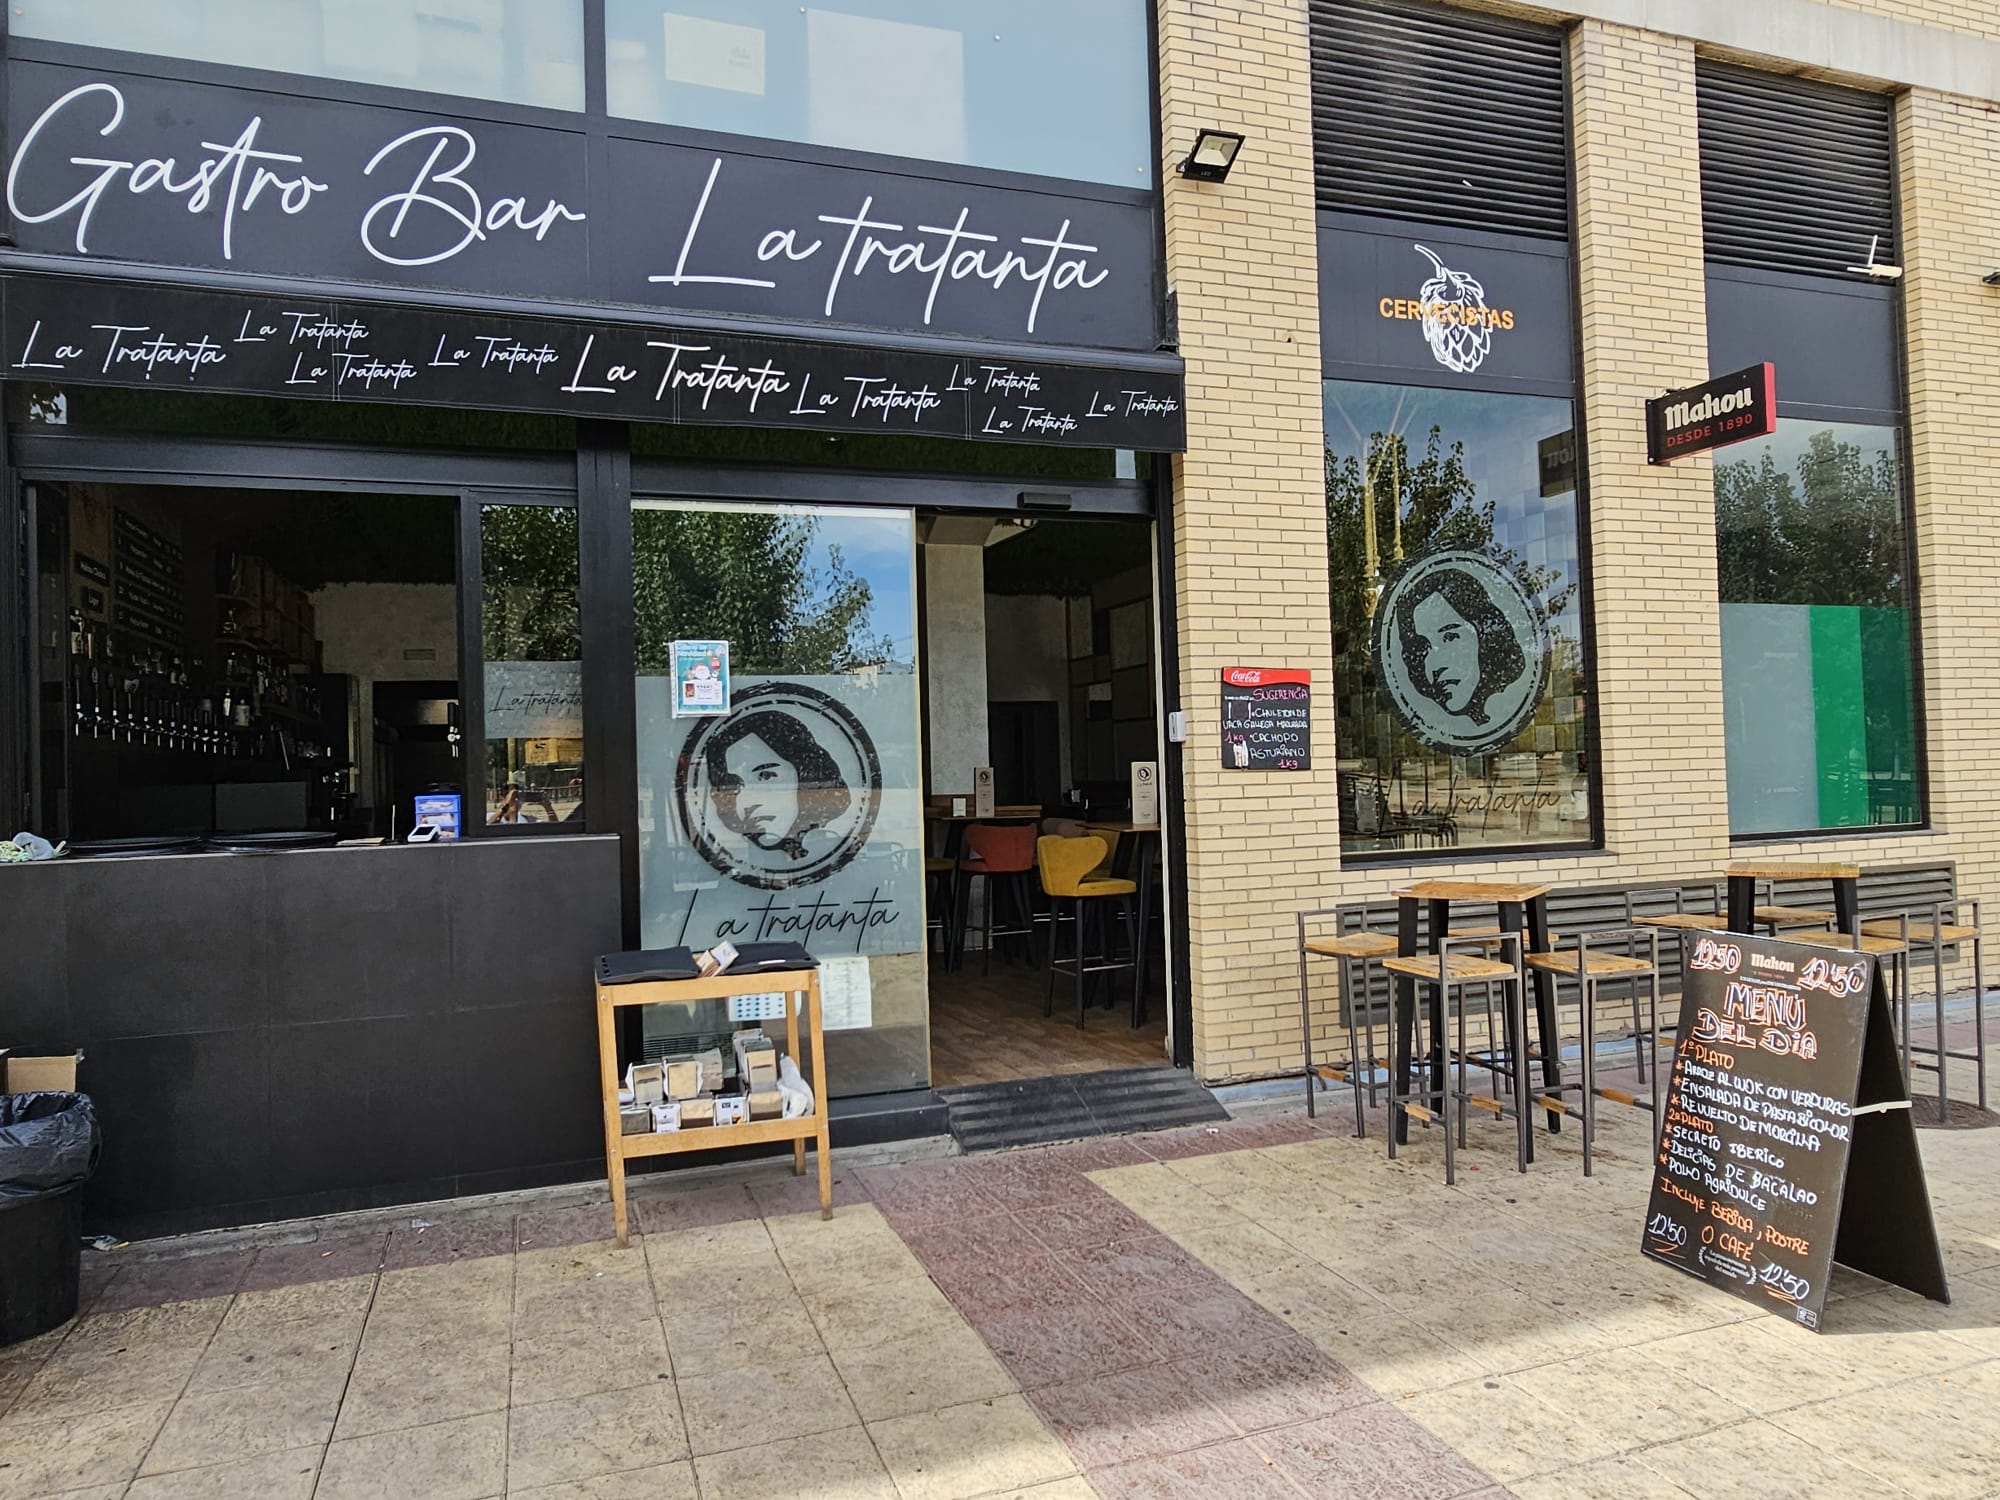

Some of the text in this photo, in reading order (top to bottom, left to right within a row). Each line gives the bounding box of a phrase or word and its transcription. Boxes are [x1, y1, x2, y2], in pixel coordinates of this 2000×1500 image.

[7, 83, 586, 266] Gastro Bar
[649, 158, 821, 288] La
[233, 310, 369, 349] La Tratanta
[1380, 298, 1514, 329] CERVECISTAS
[12, 321, 226, 380] La Tratanta
[428, 334, 559, 374] La Tratanta
[285, 352, 417, 390] La Tratanta
[561, 334, 791, 413] La Tratanta
[945, 364, 1041, 399] La Tratanta
[789, 372, 941, 423] La Tratanta
[1085, 390, 1179, 418] La Tratanta
[1664, 387, 1753, 431] Mahou
[982, 406, 1078, 437] La Tratanta
[1667, 413, 1752, 447] DESDE 1890
[488, 685, 525, 713] La
[1296, 709, 1307, 717] DE
[1222, 720, 1242, 730] VACA
[1251, 732, 1299, 743] CACHOPO
[1751, 953, 1795, 973] Mahou
[1692, 1008, 1756, 1049] DEL
[1694, 1045, 1735, 1070] PLATO
[1681, 1077, 1741, 1108] ENSALADA
[1743, 1096, 1760, 1112] DE
[1761, 1102, 1796, 1124] PASTA
[1718, 1072, 1733, 1087] AL
[1734, 1076, 1764, 1095] WOK
[1767, 1087, 1788, 1100] CON
[1792, 1090, 1851, 1117] VERDURAS
[1680, 1094, 1737, 1124] REVUELTO
[1739, 1116, 1757, 1132] DE
[1681, 1111, 1714, 1134] PLATO
[1672, 1125, 1721, 1151] SECRETO
[1669, 1156, 1700, 1181] POLLO
[1725, 1164, 1745, 1182] DE
[1750, 1171, 1818, 1205] BACALAO
[1648, 1212, 1687, 1246] 12'50
[1702, 1225, 1714, 1245] O
[1766, 1225, 1809, 1256] POSTRE
[1759, 1262, 1810, 1300] 12'50
